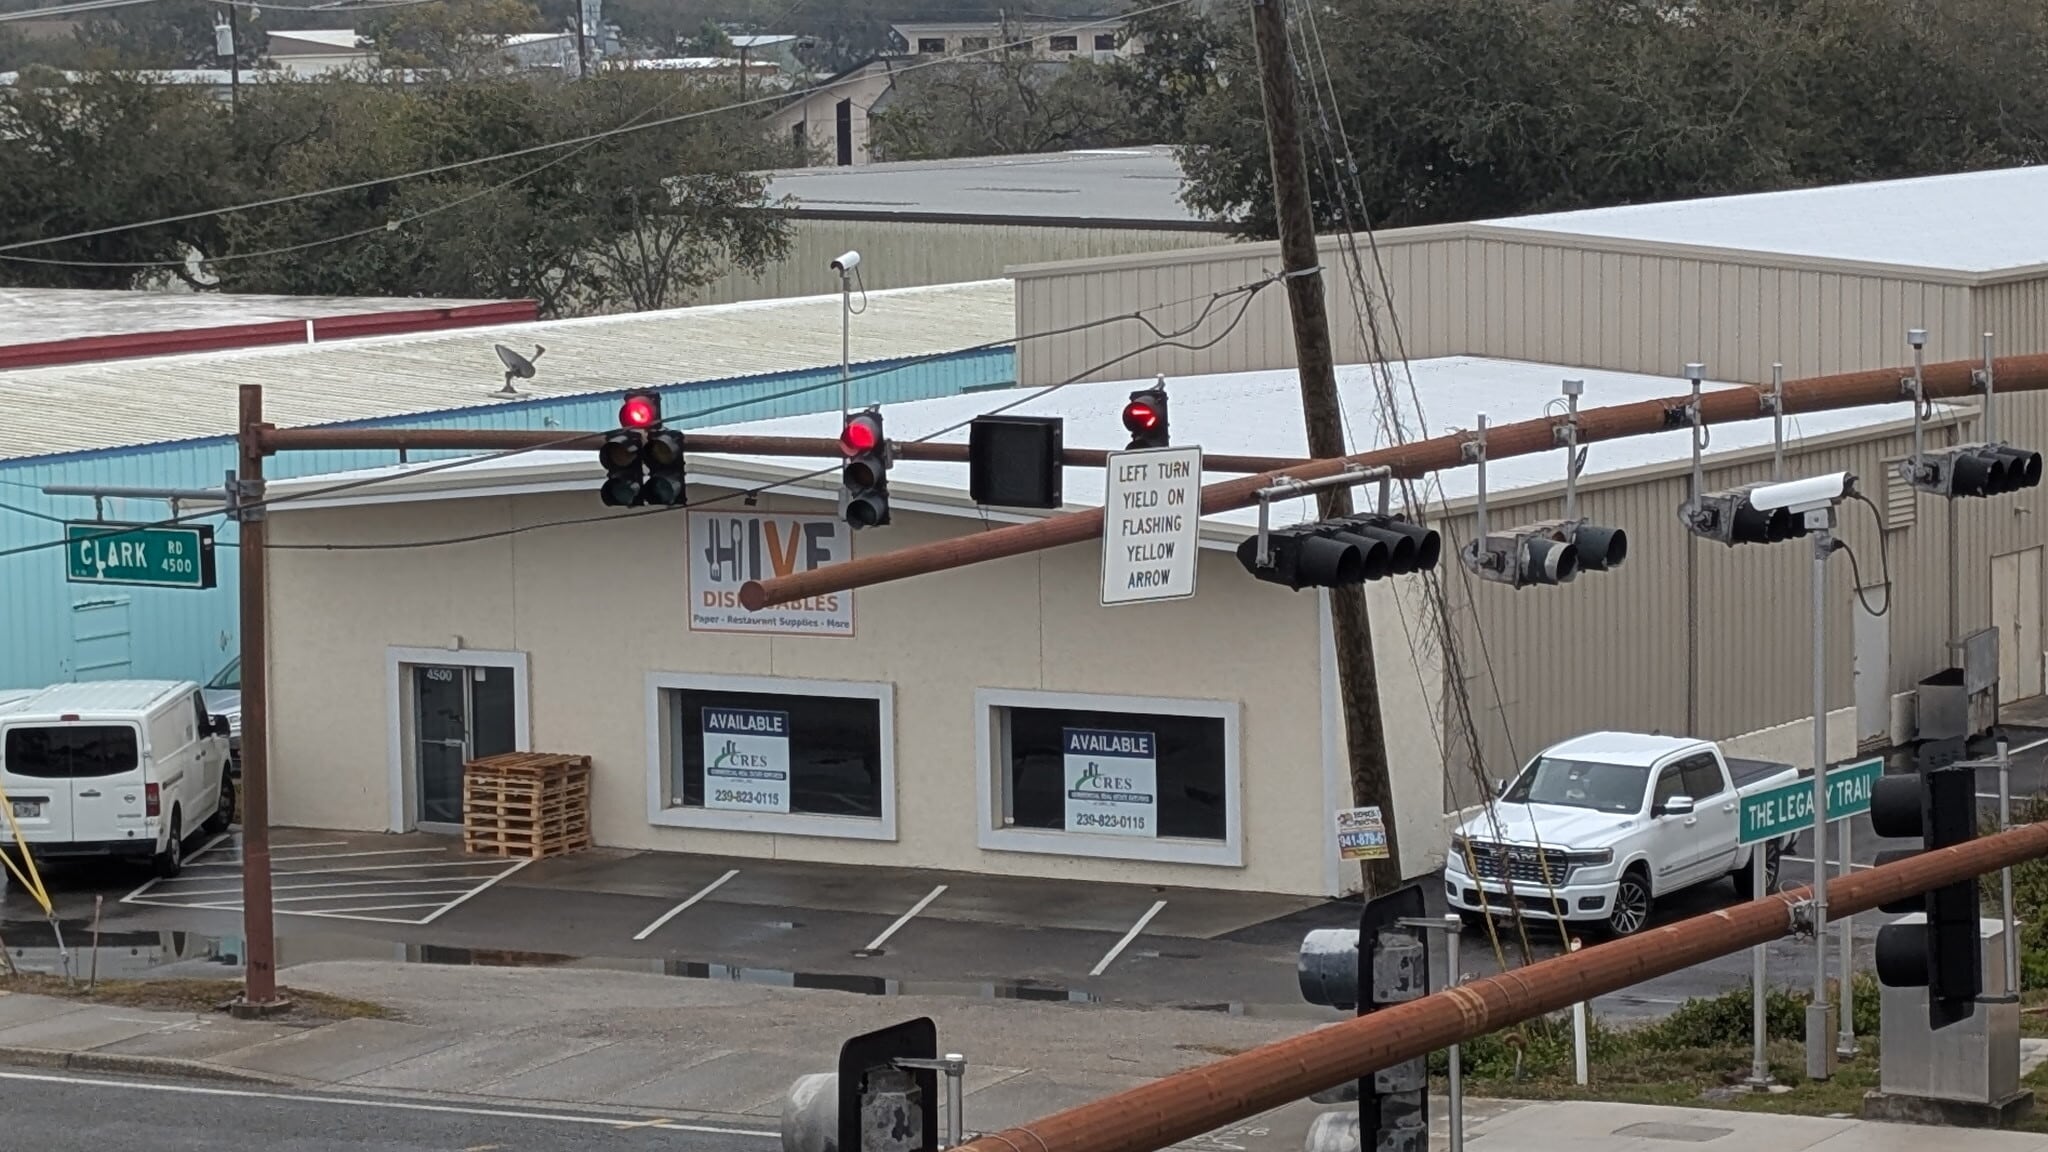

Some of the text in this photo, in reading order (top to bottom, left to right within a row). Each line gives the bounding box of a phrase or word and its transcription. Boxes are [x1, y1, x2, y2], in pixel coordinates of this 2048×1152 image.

[1120, 461, 1190, 482] LEFT TURN
[1123, 488, 1184, 509] YIELD ON
[1122, 516, 1182, 536] FLASHING
[80, 540, 183, 568] CLARK RD
[704, 518, 835, 582] HIVE
[1127, 542, 1175, 562] YELLOW
[161, 558, 192, 573] 4500
[1128, 569, 1171, 589] ARROW
[704, 590, 839, 612] DISABLES
[694, 614, 850, 629] Paper Restaurant Supplies More
[426, 668, 452, 682] 4500
[709, 713, 783, 732] AVAILABLE
[1070, 734, 1149, 754] AVAILABLE
[730, 753, 768, 768] CRES
[1092, 776, 1133, 790] CRES
[1748, 774, 1872, 831] THE LEGAY TRAIL
